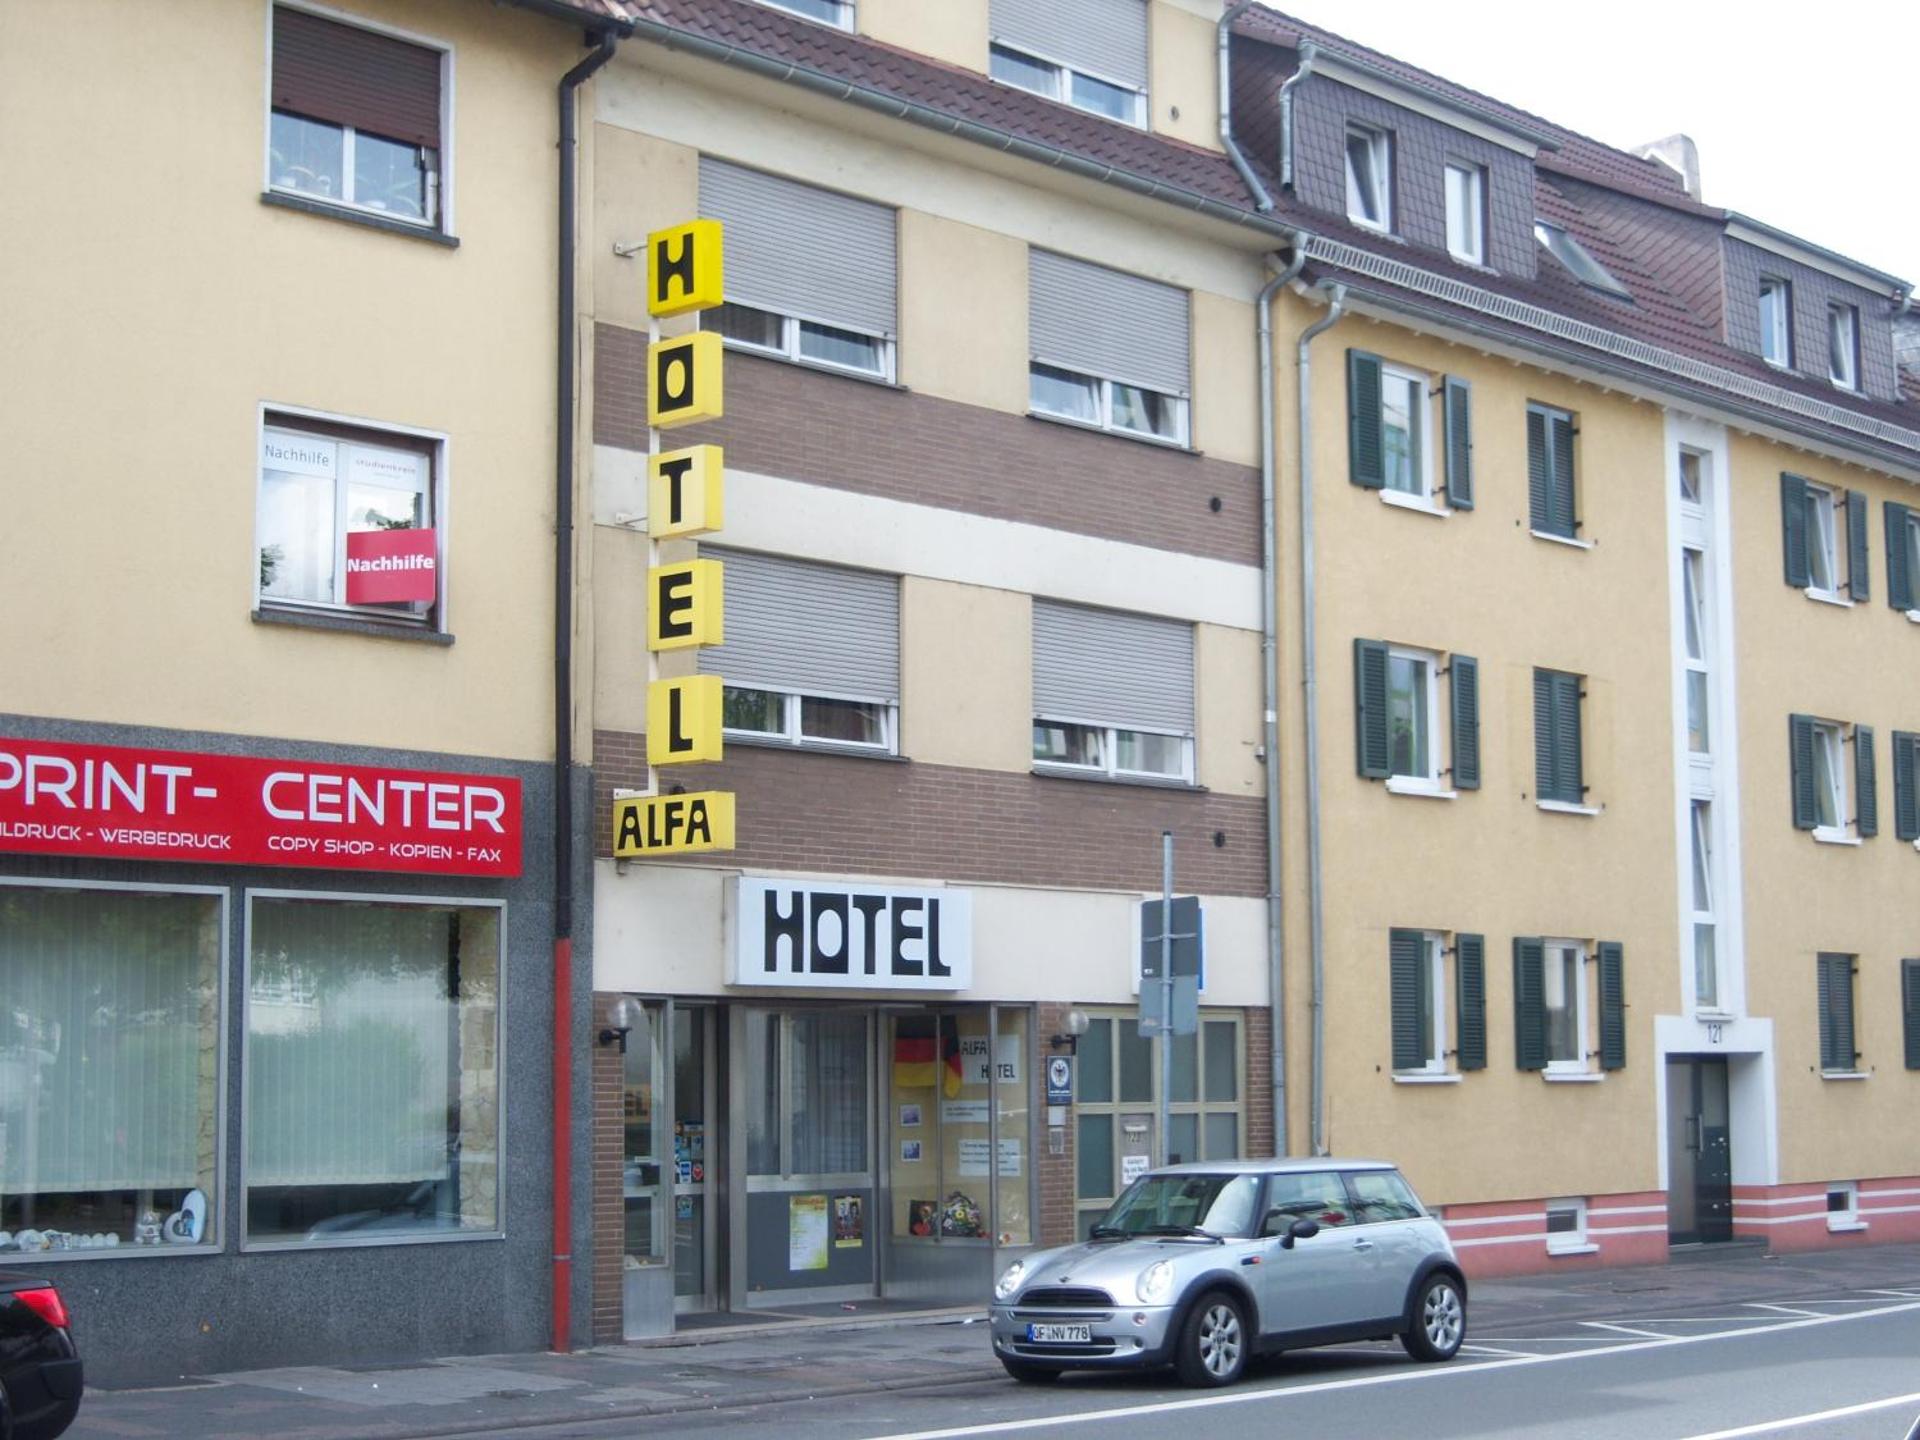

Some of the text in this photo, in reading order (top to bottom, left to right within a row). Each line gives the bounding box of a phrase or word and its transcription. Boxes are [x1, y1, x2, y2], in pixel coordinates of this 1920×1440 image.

[265, 445, 329, 467] Nachhilfe
[657, 232, 694, 753] HOTEL
[347, 554, 435, 572] Nachhilfe
[262, 771, 505, 833] CENTER
[617, 799, 711, 850] ALFA
[100, 828, 231, 849] WERBEDRUCK
[268, 836, 319, 852] COPY
[324, 839, 374, 855] SHOP
[390, 843, 452, 859] KOPIEN
[467, 848, 501, 862] FAX
[764, 889, 951, 977] HOTEL
[1708, 1023, 1722, 1044] 121
[961, 1041, 987, 1055] ALFA
[981, 1064, 1016, 1079] HTEL
[1067, 1327, 1088, 1340] 778
